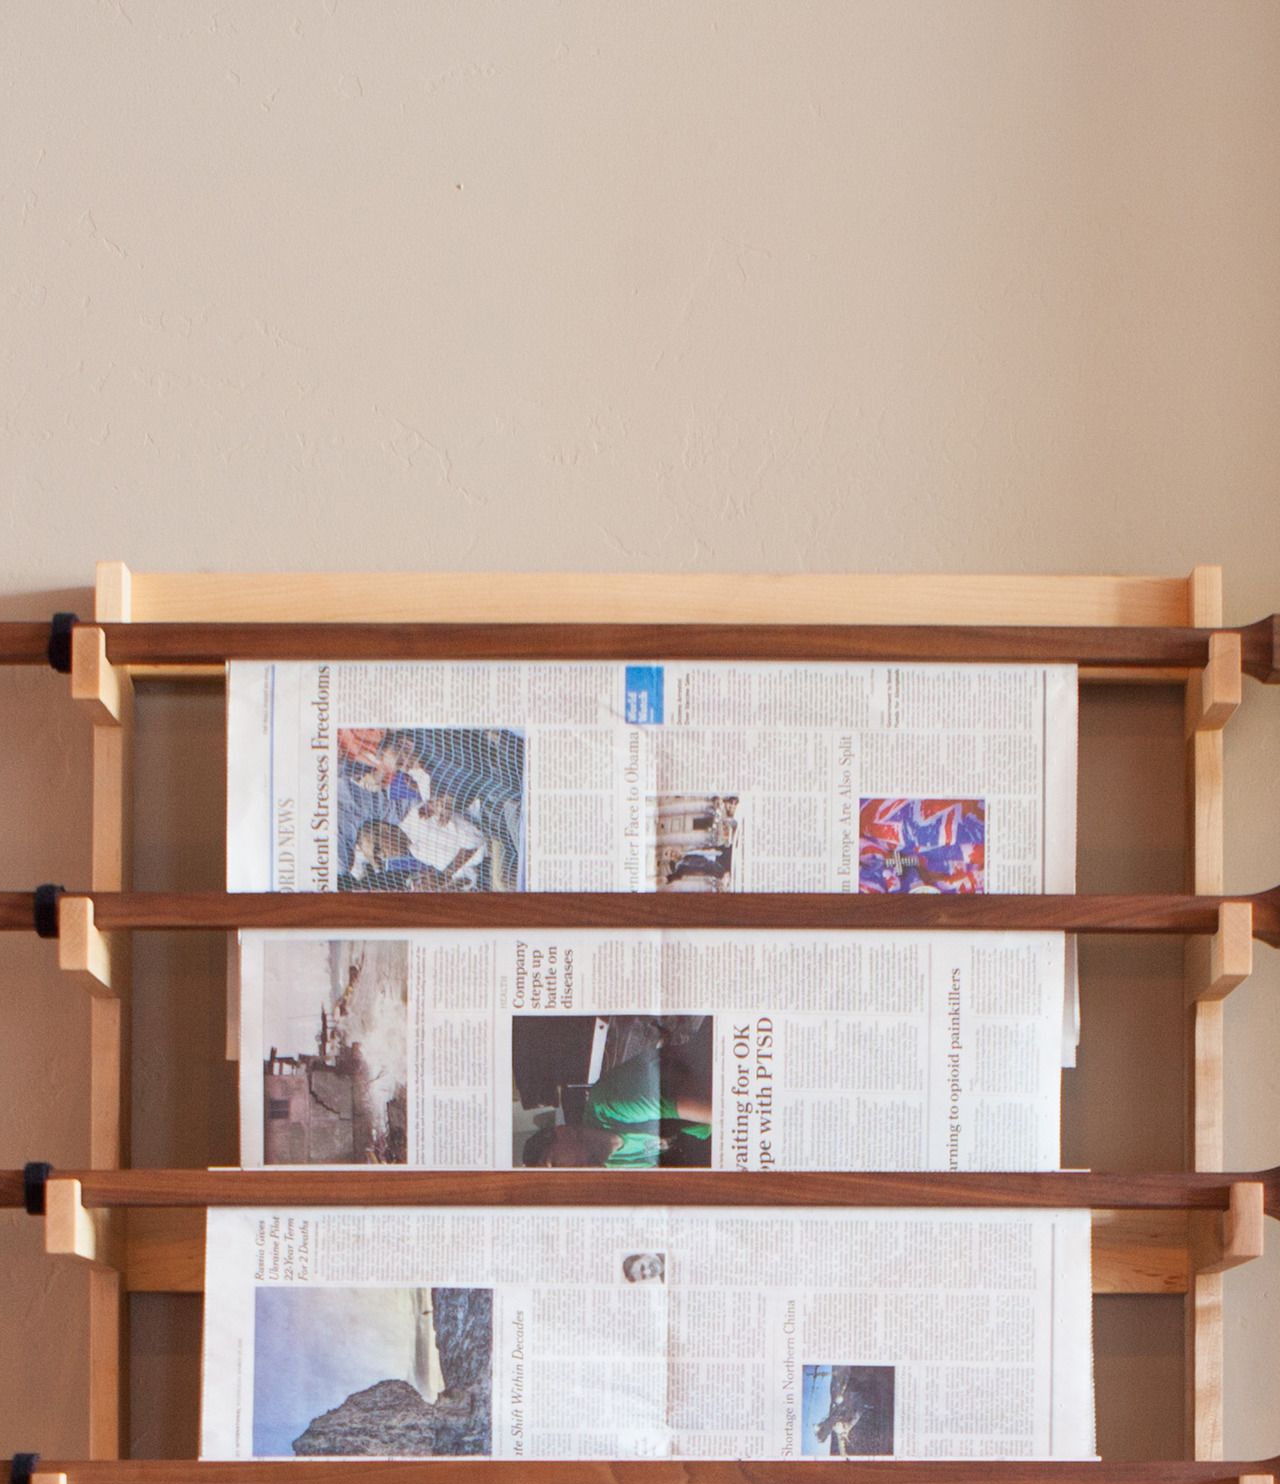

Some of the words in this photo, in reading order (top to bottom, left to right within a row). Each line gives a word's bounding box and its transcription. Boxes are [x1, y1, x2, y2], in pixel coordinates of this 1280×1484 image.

[311, 665, 331, 751] Freedoms
[624, 731, 640, 784] Obama
[837, 735, 855, 767] Split
[310, 755, 330, 832] Stresses
[626, 786, 640, 802] to
[838, 769, 852, 799] Also
[277, 797, 296, 848] NEWS
[624, 804, 640, 838] Face
[838, 801, 852, 827] Are
[837, 829, 855, 876] Europe
[512, 940, 528, 1009] Company
[531, 950, 544, 969] up
[546, 946, 557, 965] on
[531, 971, 544, 1009] steps
[544, 967, 557, 1009] battle
[560, 948, 574, 1009] diseases
[946, 967, 963, 1050] painkillers
[732, 1024, 750, 1059] OK
[756, 1017, 773, 1081] PTSD
[730, 1064, 750, 1097] for
[947, 1054, 962, 1103] opioid
[755, 1086, 772, 1135] with
[947, 1105, 960, 1121] to
[510, 1310, 525, 1362] Decades
[782, 1299, 795, 1335] China
[510, 1363, 524, 1406] Within
[782, 1337, 795, 1391] Northern
[782, 1393, 794, 1405] in
[510, 1409, 524, 1440] Shift
[781, 1407, 797, 1457] Shortage
